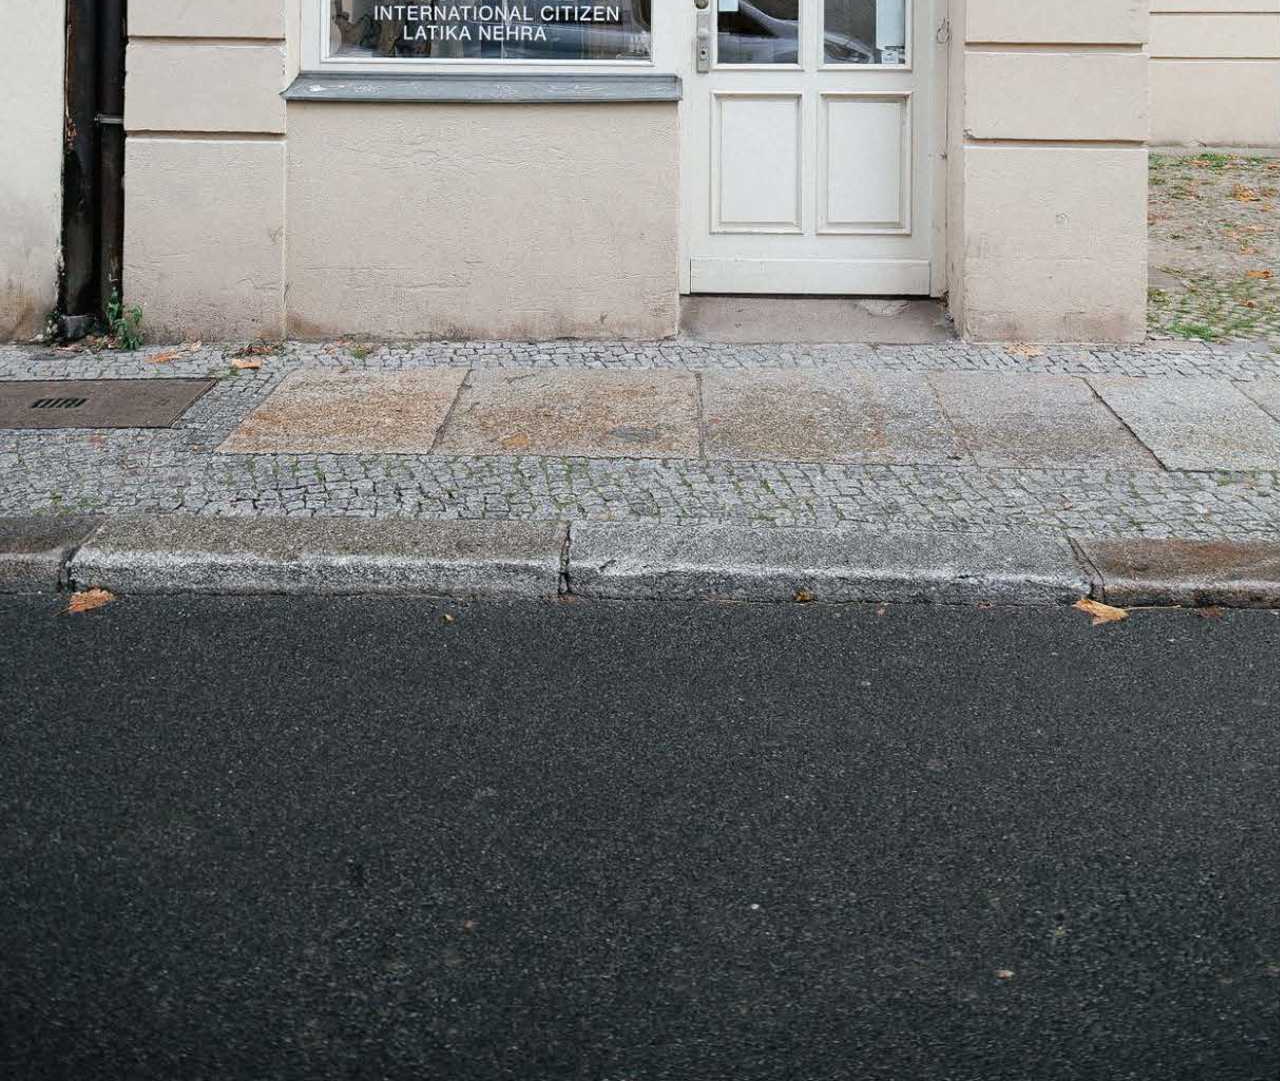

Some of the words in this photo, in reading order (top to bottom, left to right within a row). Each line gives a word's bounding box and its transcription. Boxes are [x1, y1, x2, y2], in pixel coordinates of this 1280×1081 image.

[373, 5, 535, 21] INTERNATIONAL
[540, 5, 620, 21] CITIZEN
[403, 25, 472, 41] LATIKA
[479, 25, 547, 41] NEHRA
